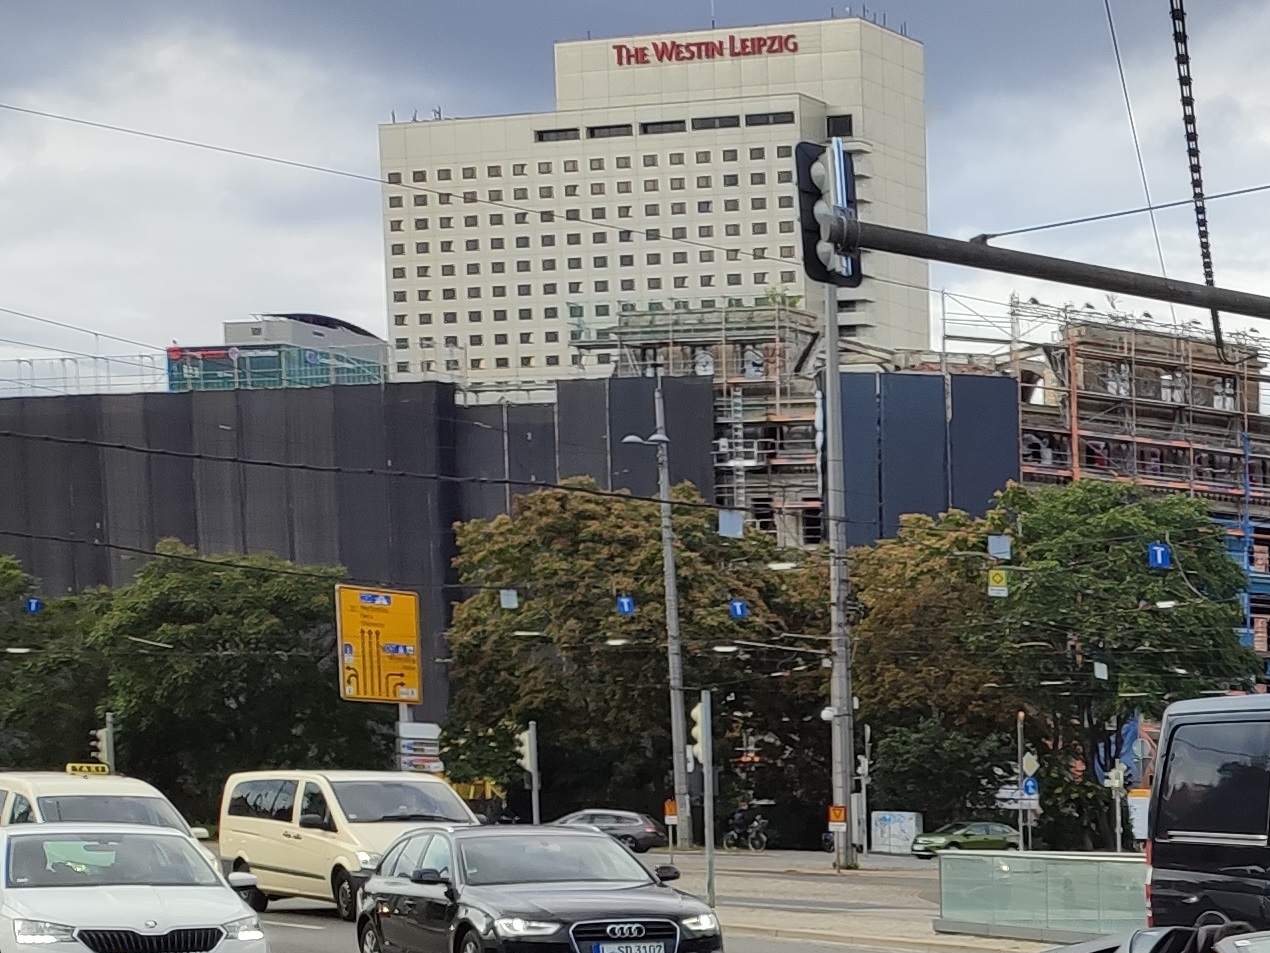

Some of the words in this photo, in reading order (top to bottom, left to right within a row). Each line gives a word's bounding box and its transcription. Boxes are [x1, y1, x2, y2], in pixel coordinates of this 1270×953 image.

[612, 44, 651, 66] THE
[651, 40, 724, 63] WESTIN
[728, 34, 798, 57] LEIPZIG
